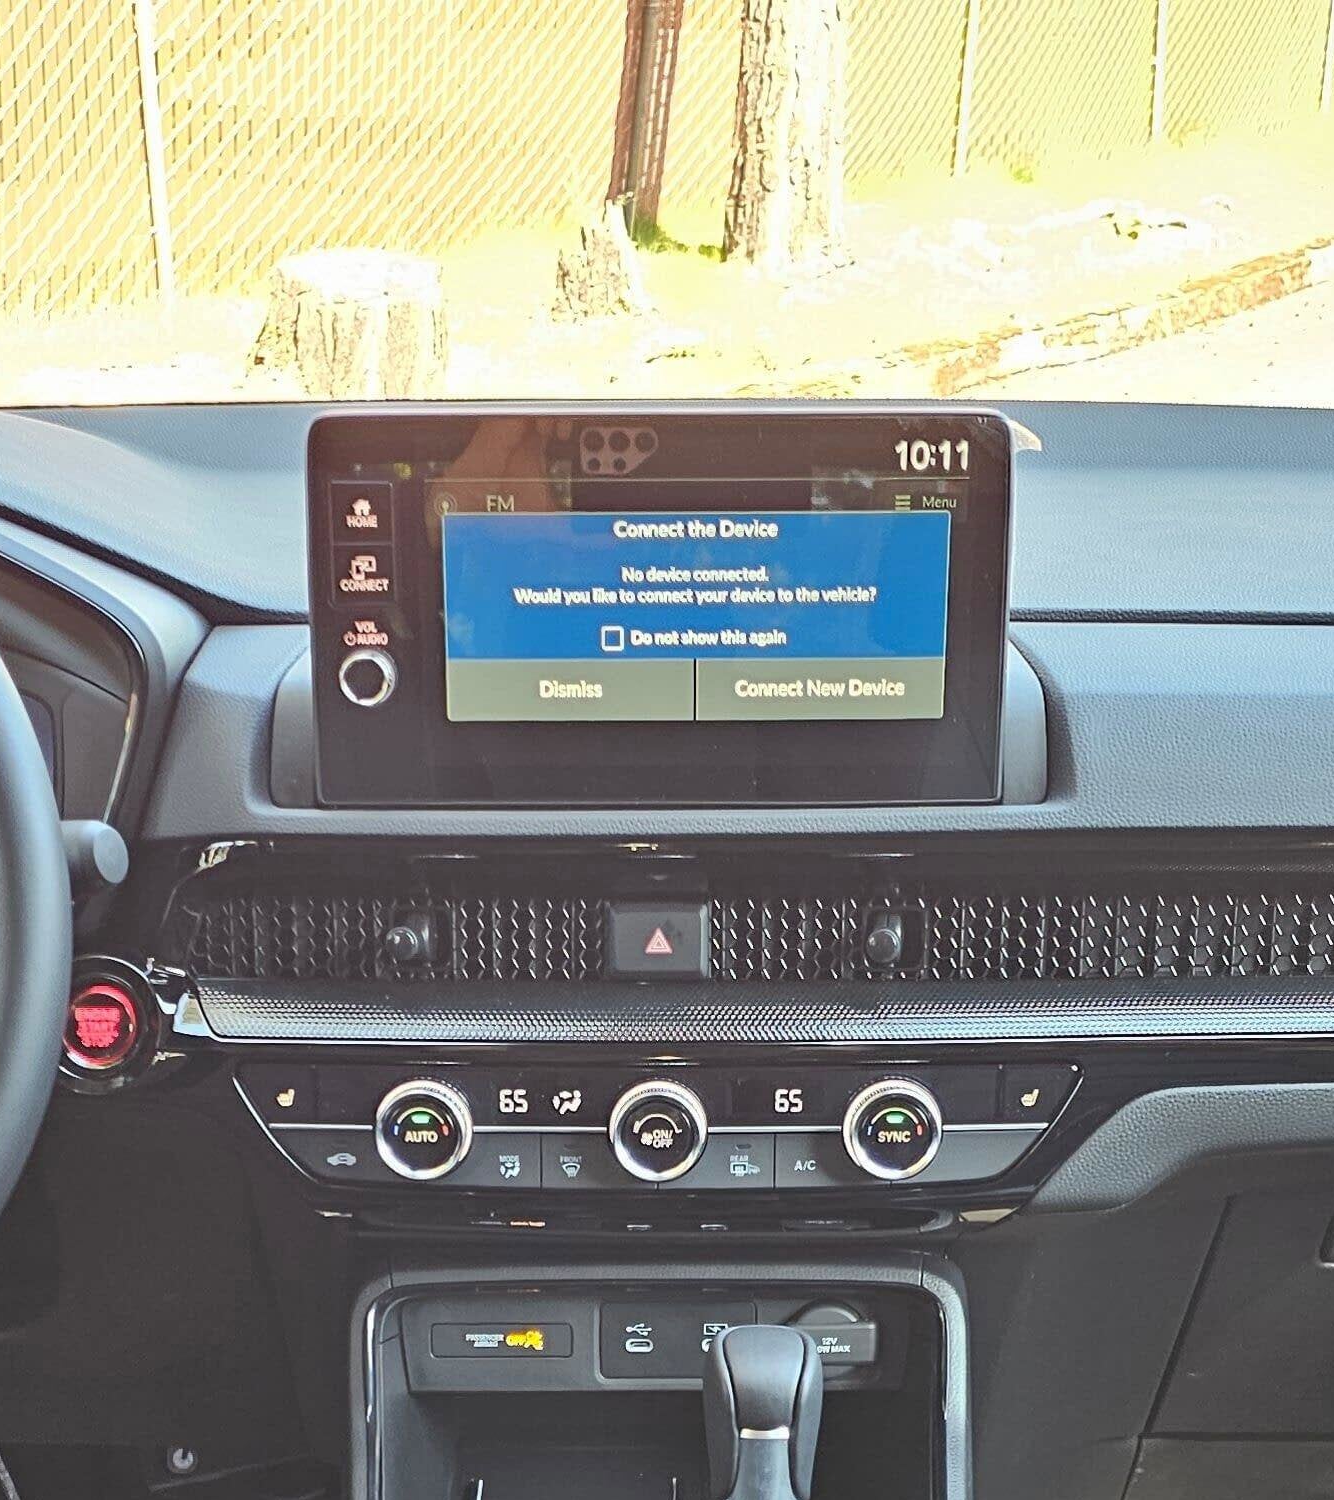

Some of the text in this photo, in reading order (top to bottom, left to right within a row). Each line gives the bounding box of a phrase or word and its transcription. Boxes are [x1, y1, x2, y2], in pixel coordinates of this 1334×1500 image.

[894, 440, 969, 471] 10:11
[486, 495, 515, 512] FM
[922, 495, 957, 509] Menu
[346, 515, 378, 529] HOME
[613, 519, 779, 539] Connect the Device
[621, 565, 769, 582] No device connected.
[339, 578, 390, 593] CONNECT
[513, 586, 877, 607] Would you like to connect your device to the vehicle?
[355, 620, 378, 634] VOL
[357, 633, 389, 646] AUDIO
[630, 628, 787, 648] Do not show this again
[539, 680, 603, 698] Dismiss
[734, 678, 906, 698] Connect New Device
[498, 1088, 529, 1113] 65
[774, 1089, 804, 1113] 65
[404, 1130, 438, 1143] AUTO
[653, 1128, 673, 1140] ON/
[877, 1130, 911, 1144] SYNC
[653, 1138, 673, 1149] OFF
[498, 1154, 521, 1163] MODE
[559, 1155, 582, 1163] FRONT
[794, 1160, 816, 1171] A/C
[822, 1338, 838, 1346] 12V
[830, 1345, 851, 1353] MAX
